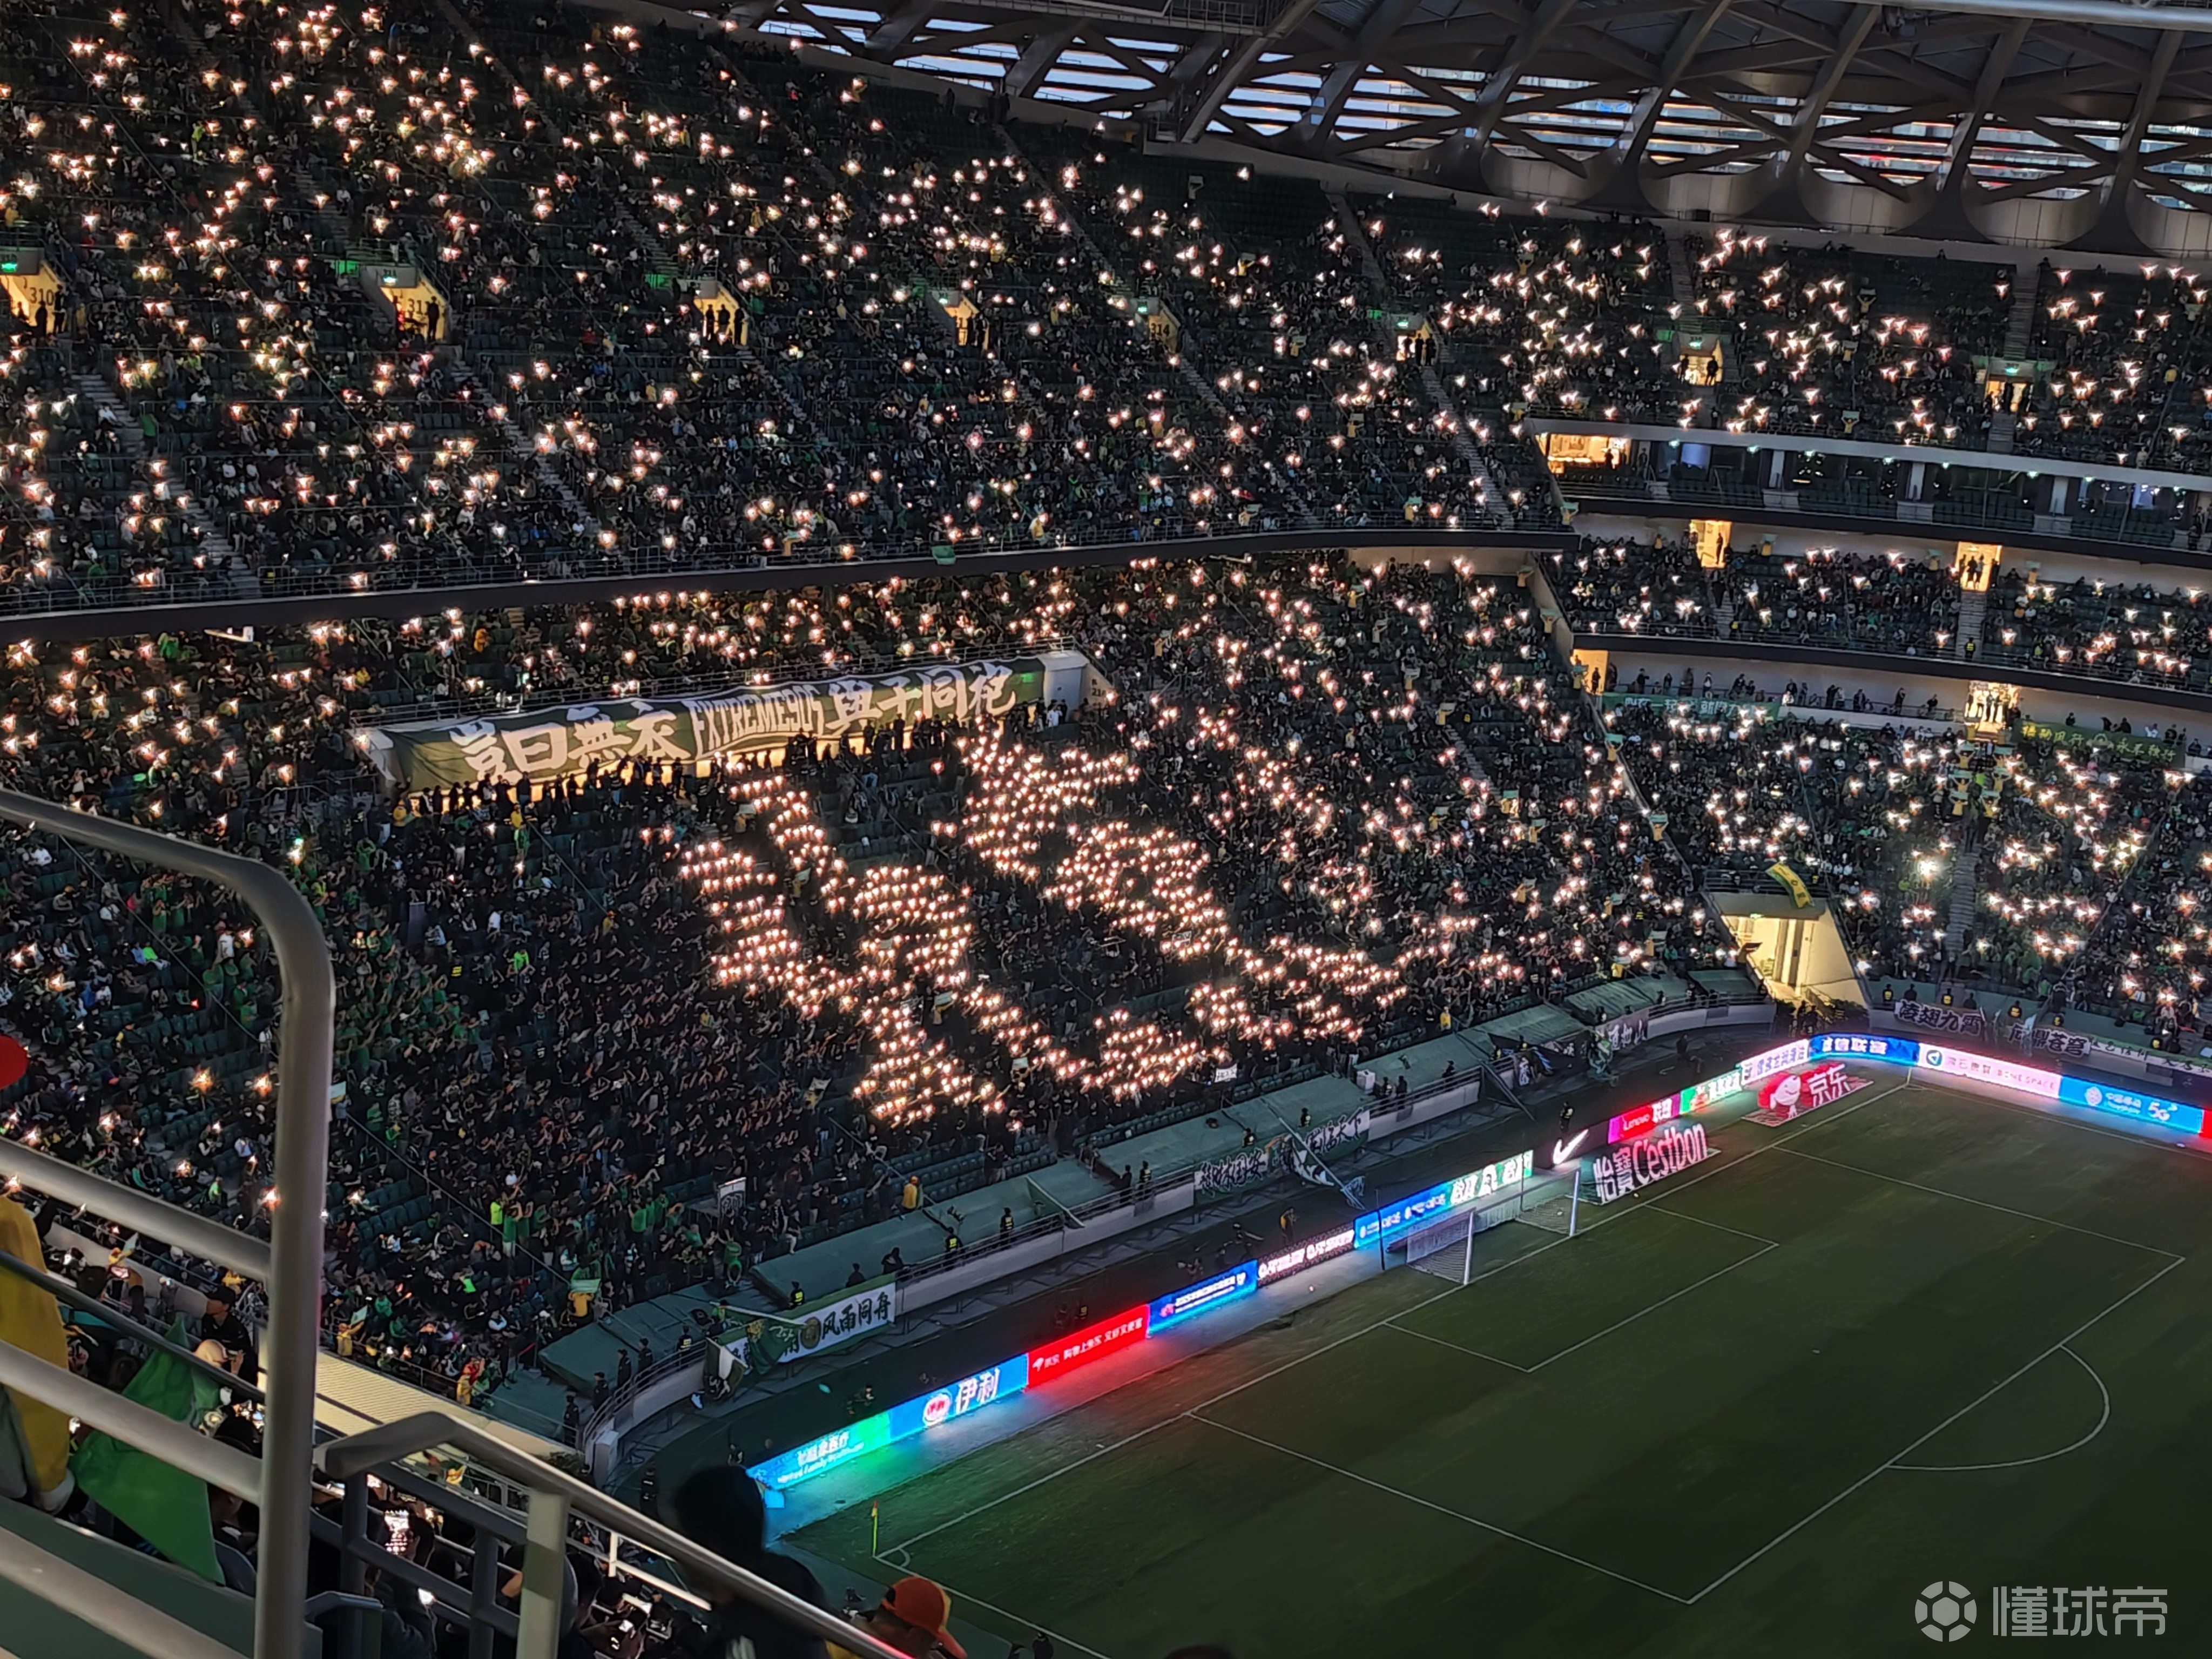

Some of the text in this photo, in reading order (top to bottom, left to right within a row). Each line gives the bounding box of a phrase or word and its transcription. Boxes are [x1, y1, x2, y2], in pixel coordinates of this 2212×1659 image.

[30, 287, 54, 306] 310
[1150, 323, 1170, 336] 314
[1808, 1064, 1851, 1107] 京东
[1633, 1123, 1708, 1184] C'estbon
[821, 1292, 892, 1339] 风雨同舟
[955, 1368, 1001, 1415] 伊利
